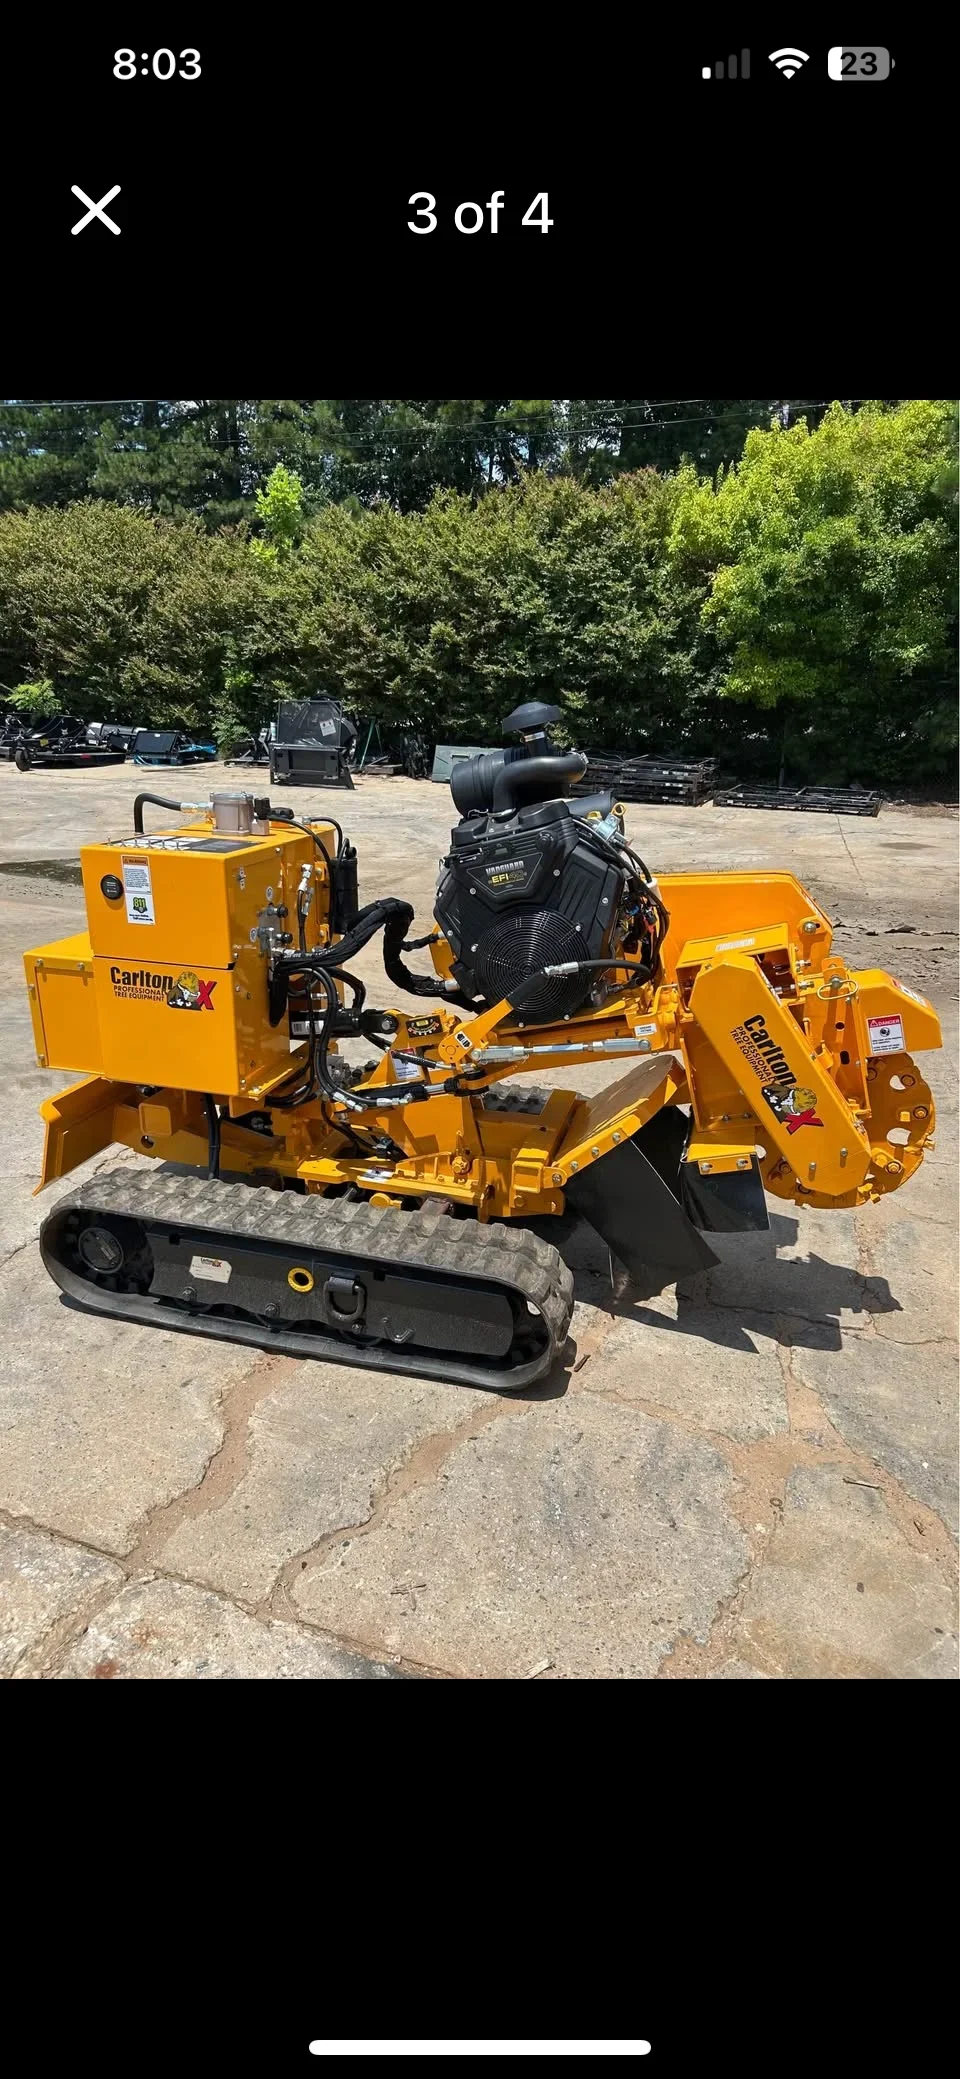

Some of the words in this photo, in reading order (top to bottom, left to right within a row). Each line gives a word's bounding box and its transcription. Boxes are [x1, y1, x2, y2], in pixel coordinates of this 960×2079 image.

[491, 873, 509, 883] EFI
[134, 898, 145, 908] 811
[110, 966, 173, 991] Carlton
[114, 985, 165, 996] PROFESSIONAL
[129, 993, 164, 1002] EQUIPMENT
[730, 1030, 744, 1045] TREE
[740, 1045, 768, 1083] EQUIPMENT
[736, 1026, 776, 1082] PROFESSIONAL
[743, 1014, 797, 1086] Carlton
